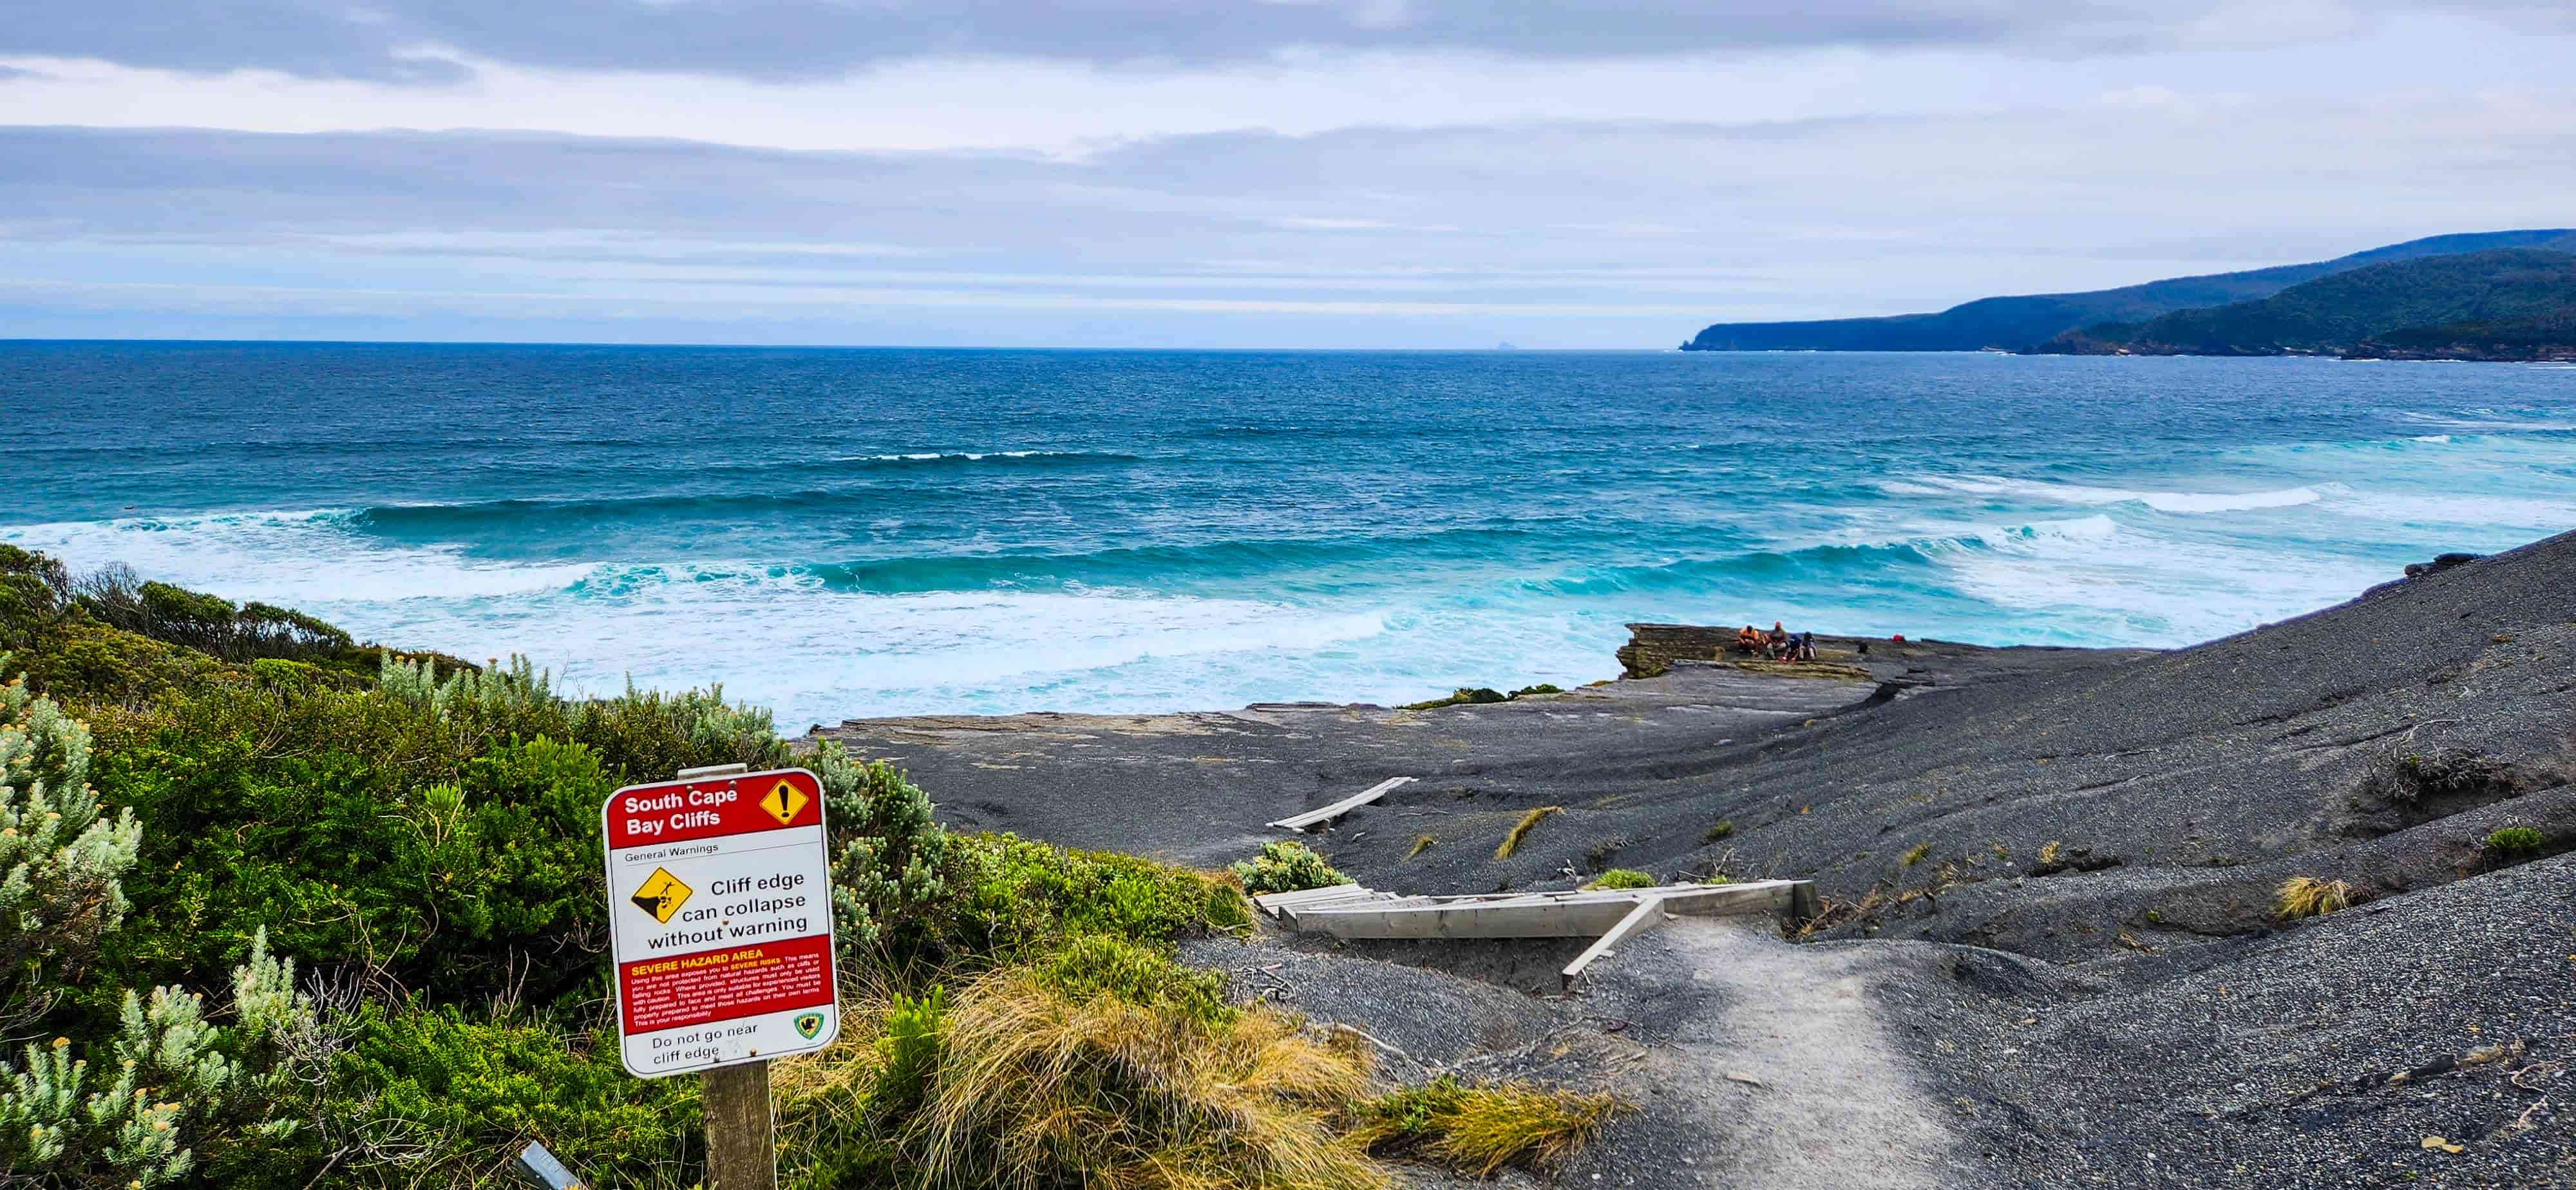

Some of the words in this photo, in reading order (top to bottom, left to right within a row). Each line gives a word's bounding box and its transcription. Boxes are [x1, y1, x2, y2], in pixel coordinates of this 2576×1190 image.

[625, 793, 683, 813] South
[688, 790, 737, 806] Cape
[627, 819, 664, 835] Bay
[670, 811, 720, 829] Cliffs
[625, 850, 666, 862] General
[670, 845, 718, 856] Warnings
[712, 877, 751, 895] Cliff
[757, 874, 804, 890] edge
[683, 908, 717, 922] can
[724, 896, 805, 916] collapse
[648, 927, 723, 949] without
[730, 918, 807, 938] warning
[632, 961, 678, 976] SEVERE
[681, 954, 728, 968] HAZARD
[732, 949, 763, 961] AREA
[730, 961, 757, 970] SEVERE
[672, 976, 701, 987] protected
[730, 976, 759, 984] structures
[762, 976, 799, 986] experienced
[634, 1012, 659, 1021] properly
[661, 1006, 690, 1016] prepared
[649, 1001, 677, 1012] prepared
[653, 1038, 671, 1048] Do
[677, 1033, 699, 1044] not
[705, 1031, 722, 1043] go
[728, 1025, 757, 1036] near
[654, 1050, 679, 1064] cliff
[685, 1047, 719, 1059] edge
